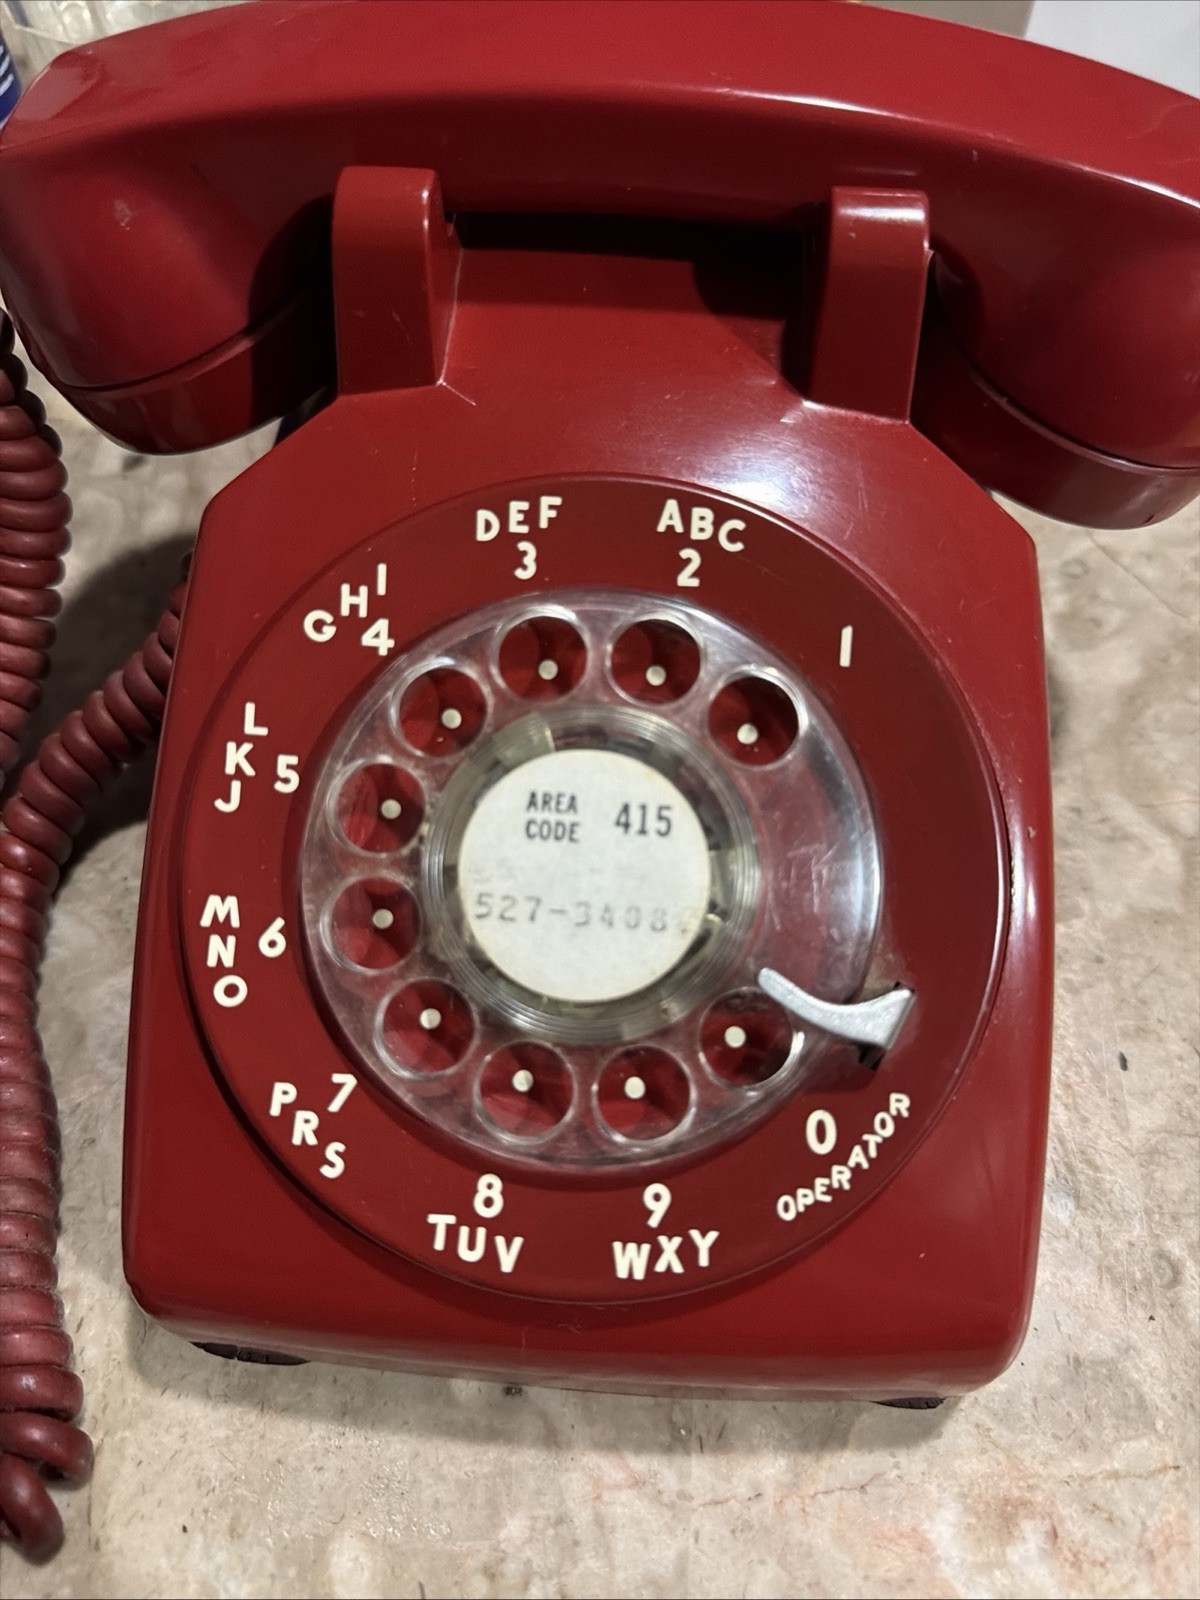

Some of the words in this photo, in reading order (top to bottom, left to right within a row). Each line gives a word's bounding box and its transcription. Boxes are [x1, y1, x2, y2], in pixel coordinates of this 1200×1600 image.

[476, 495, 563, 542] DEF
[656, 498, 746, 553] ABC
[514, 540, 537, 580] 3
[676, 547, 701, 587] 2
[361, 618, 395, 656] 4
[273, 754, 300, 794] 5
[526, 790, 578, 813] AREA
[614, 802, 674, 837] 415
[525, 820, 581, 842] CODE
[258, 916, 287, 958] 6
[327, 1073, 358, 1113] 7
[805, 1109, 837, 1155] 0
[776, 1092, 911, 1222] OPERATOR
[473, 1173, 504, 1219] 8
[643, 1182, 672, 1228] 9
[426, 1213, 524, 1273] TUV
[612, 1228, 720, 1281] WXY
